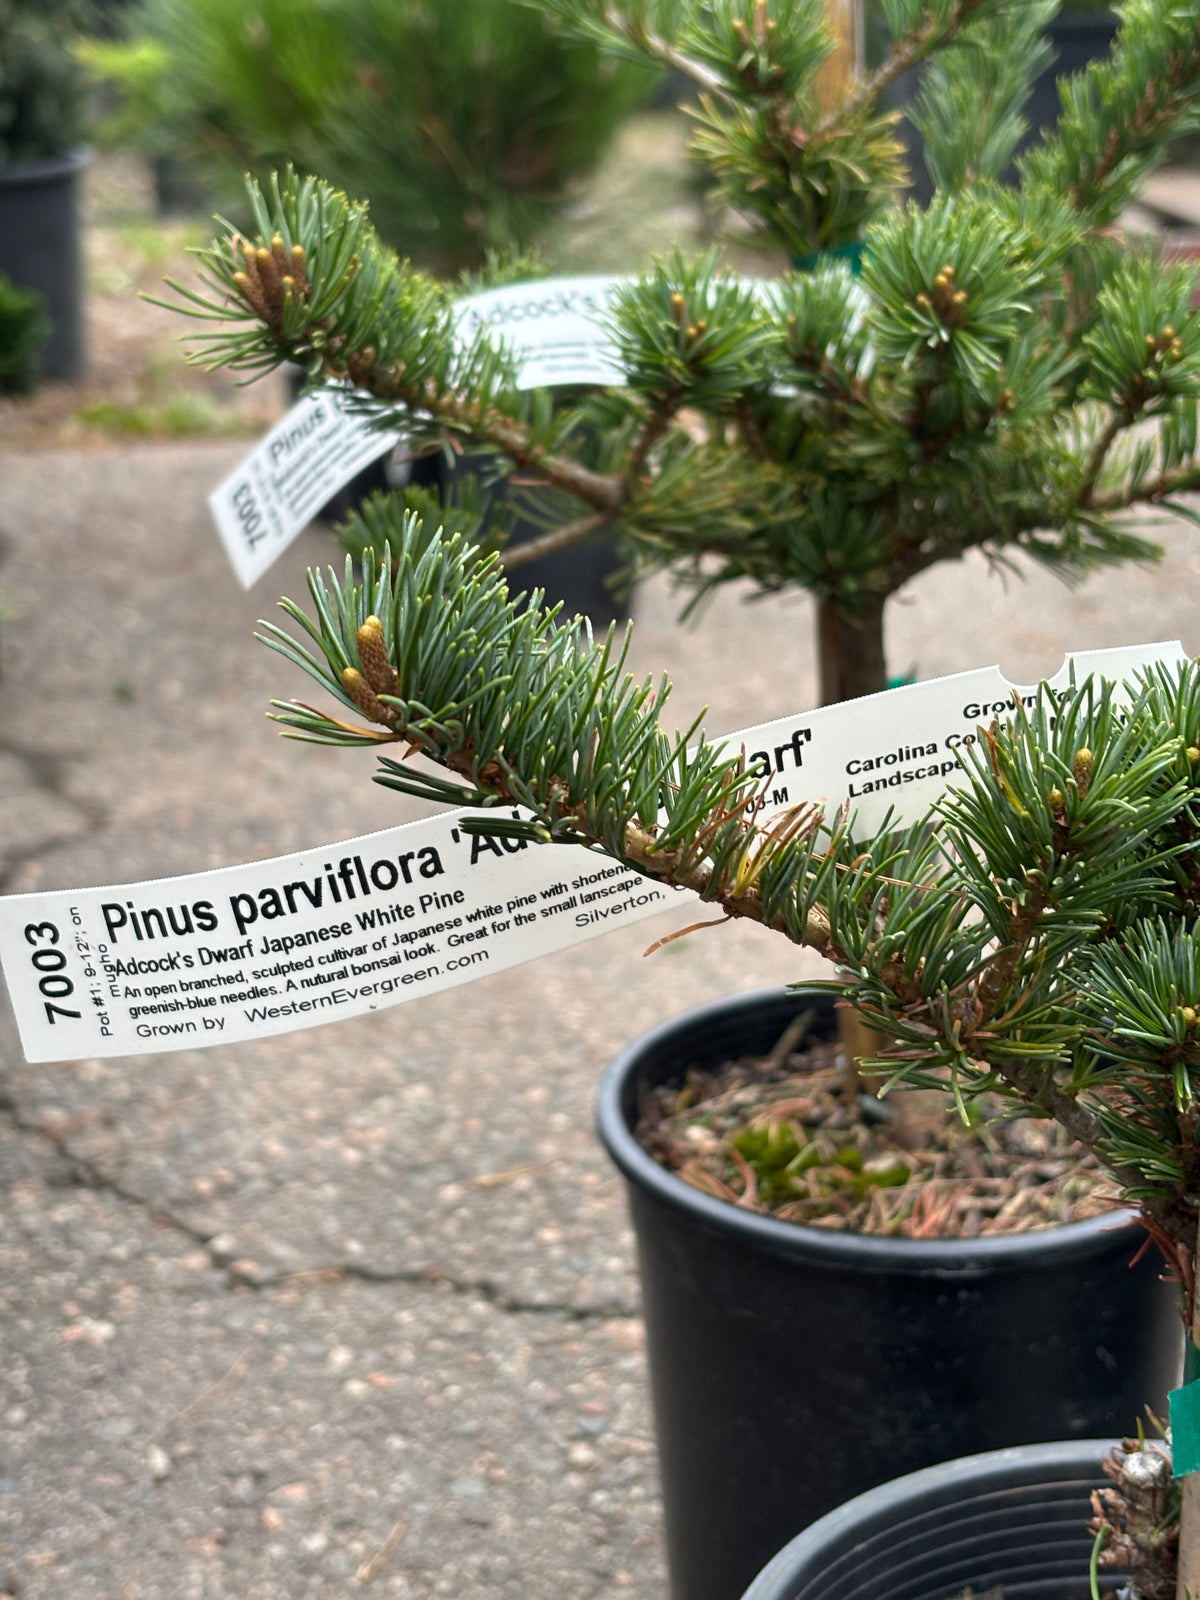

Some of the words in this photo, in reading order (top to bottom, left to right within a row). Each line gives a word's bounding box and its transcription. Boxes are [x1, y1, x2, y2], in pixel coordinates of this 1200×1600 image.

[270, 407, 325, 467] Pinus
[845, 742, 938, 775] Carolina
[101, 900, 219, 944] Pinus
[229, 845, 446, 936] parviflora
[115, 950, 195, 977] Adcock's
[198, 938, 255, 967] Dwarf
[260, 920, 353, 955] Japanese
[355, 904, 416, 931] White
[418, 889, 466, 914] Pine
[124, 985, 142, 998] An
[144, 982, 178, 999] open
[179, 970, 249, 992] branched,
[252, 956, 314, 979] sculpted
[318, 943, 368, 966] cultivar
[372, 936, 388, 951] of
[392, 917, 463, 946] Japanese
[466, 901, 504, 923] white
[506, 891, 537, 913] pine
[539, 882, 569, 899] with
[24, 921, 82, 1025] 7003
[129, 993, 217, 1020] greenish-blue
[220, 985, 283, 1004] needles.
[286, 979, 298, 992] A
[300, 966, 349, 989] nutural
[351, 951, 402, 976] bonsai
[404, 942, 441, 961] look.
[447, 926, 490, 948] Great
[490, 918, 511, 935] for
[513, 911, 537, 927] the
[540, 893, 578, 917] small
[580, 875, 643, 905] lanscape
[136, 1020, 198, 1038] Grown
[202, 1015, 226, 1031] by
[243, 948, 490, 1023] WesternEvergreen.com
[574, 888, 666, 929] Silverton,
[96, 1011, 113, 1037] Pot
